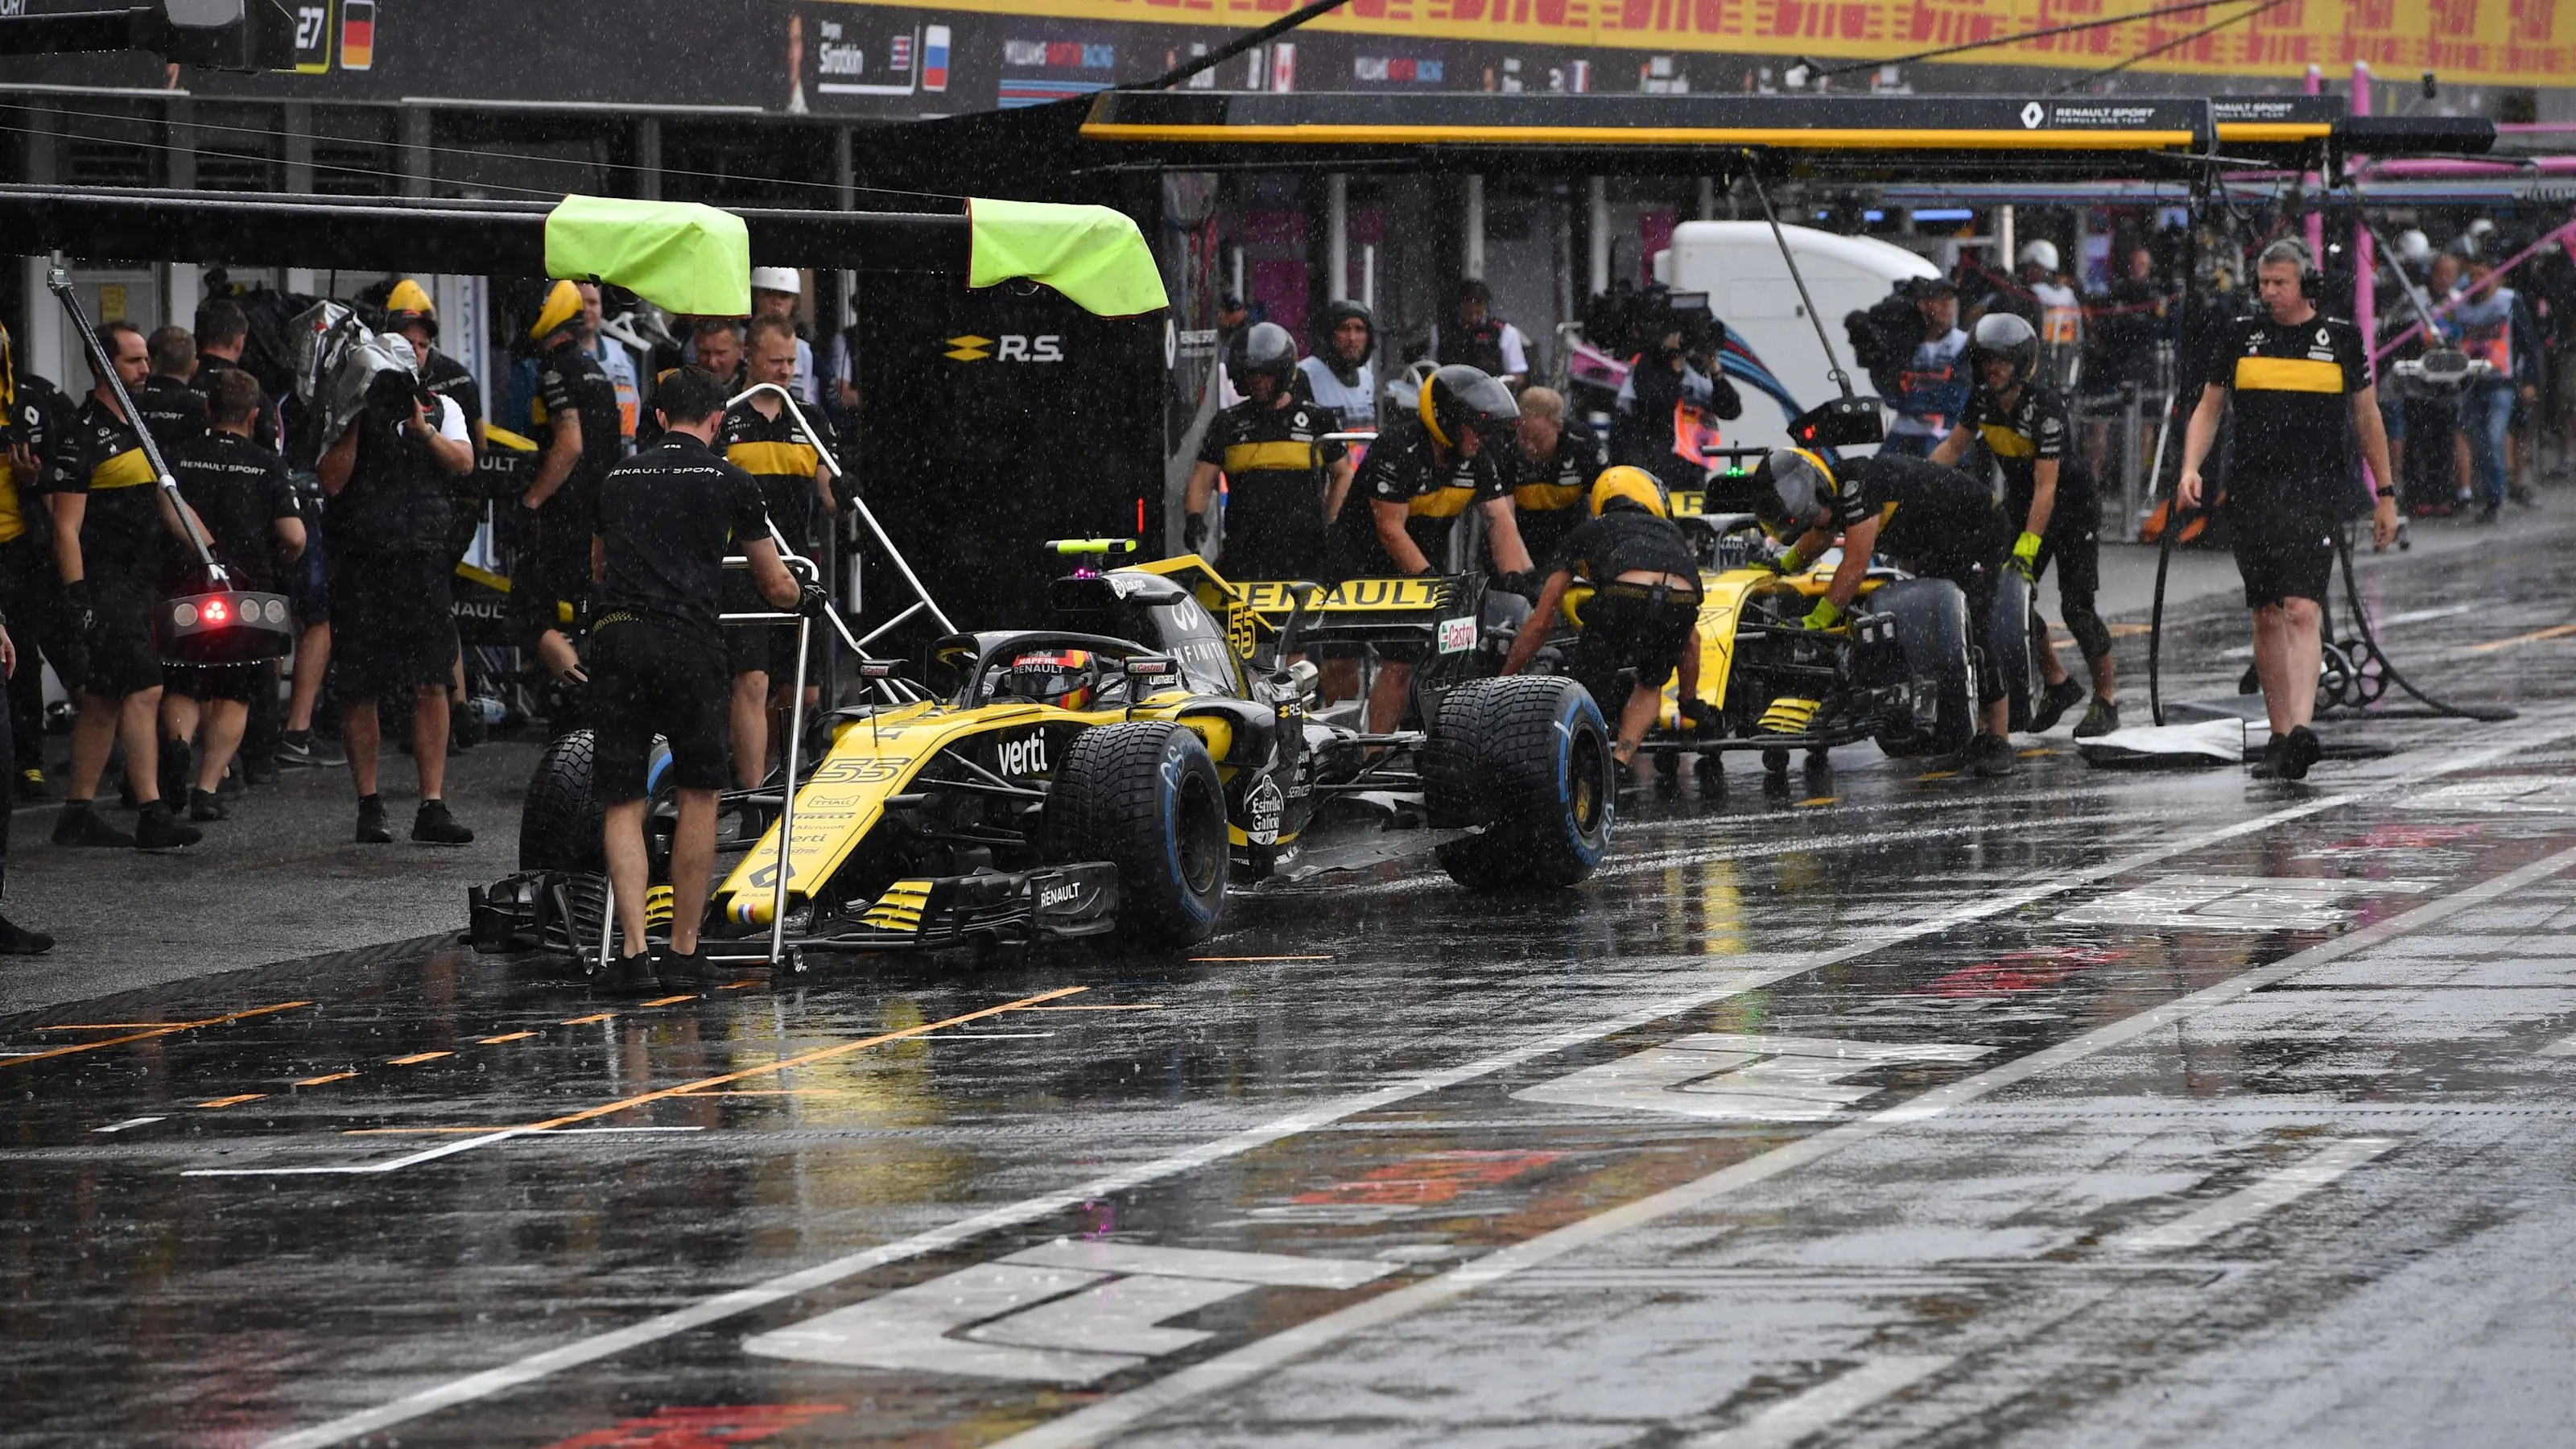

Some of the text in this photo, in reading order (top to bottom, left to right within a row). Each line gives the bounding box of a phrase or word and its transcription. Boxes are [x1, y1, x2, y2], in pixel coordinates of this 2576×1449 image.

[295, 6, 325, 49] 27
[2056, 108, 2156, 118] RENAULT SPORT
[149, 411, 184, 420] SPORT
[180, 460, 266, 476] RENAULT SPORT
[673, 467, 724, 477] SPORT
[1449, 621, 1474, 648] Castrol
[1166, 642, 1225, 664] INFINITI
[1014, 665, 1064, 675] RENAULT
[1137, 663, 1164, 672] Castrol
[997, 727, 1048, 777] verti
[807, 758, 912, 783] 55
[1251, 795, 1281, 814] Estrella
[1253, 812, 1279, 831] Galicia
[791, 834, 827, 842] erti
[1041, 882, 1080, 908] RENAULT
